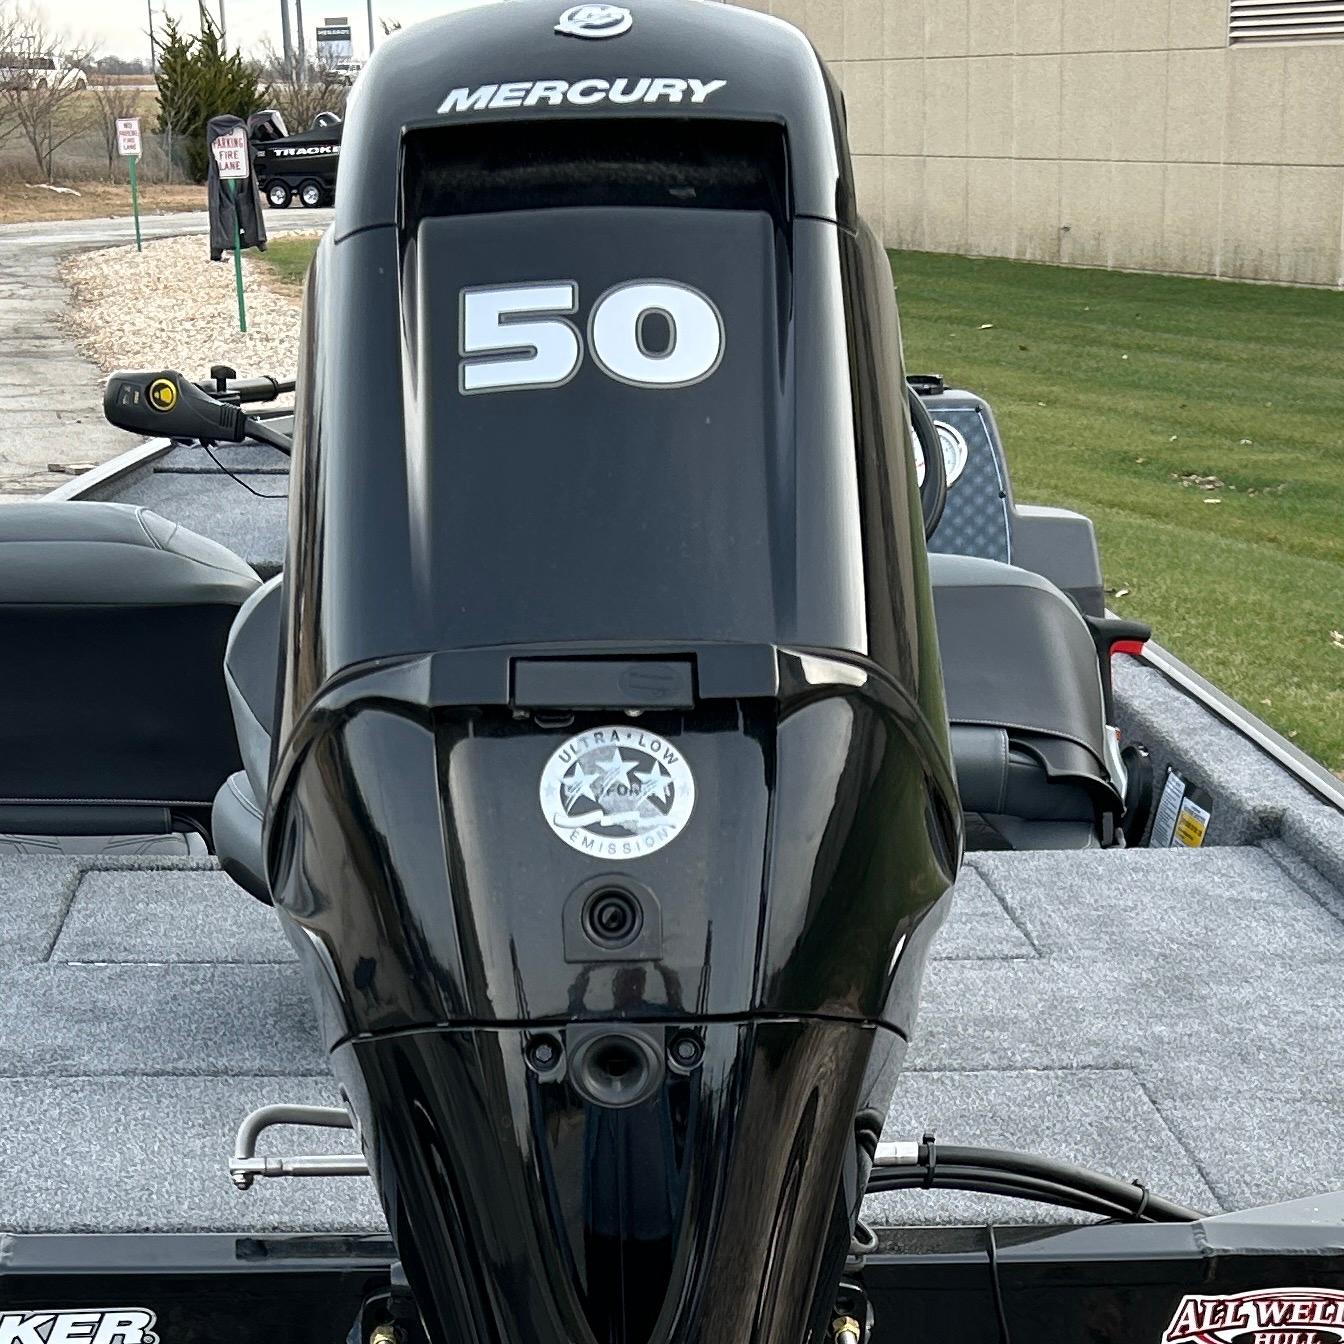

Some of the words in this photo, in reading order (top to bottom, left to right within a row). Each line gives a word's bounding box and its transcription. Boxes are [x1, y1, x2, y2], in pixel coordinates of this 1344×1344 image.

[438, 78, 726, 114] MERCURY
[219, 150, 239, 160] FIRE
[219, 160, 241, 171] LANE
[273, 145, 341, 157] TRACKE
[460, 279, 724, 394] 50
[558, 729, 620, 765] ULTRA
[638, 733, 680, 766] LOW
[569, 827, 671, 855] EMISSION
[1167, 1299, 1250, 1342] ALL
